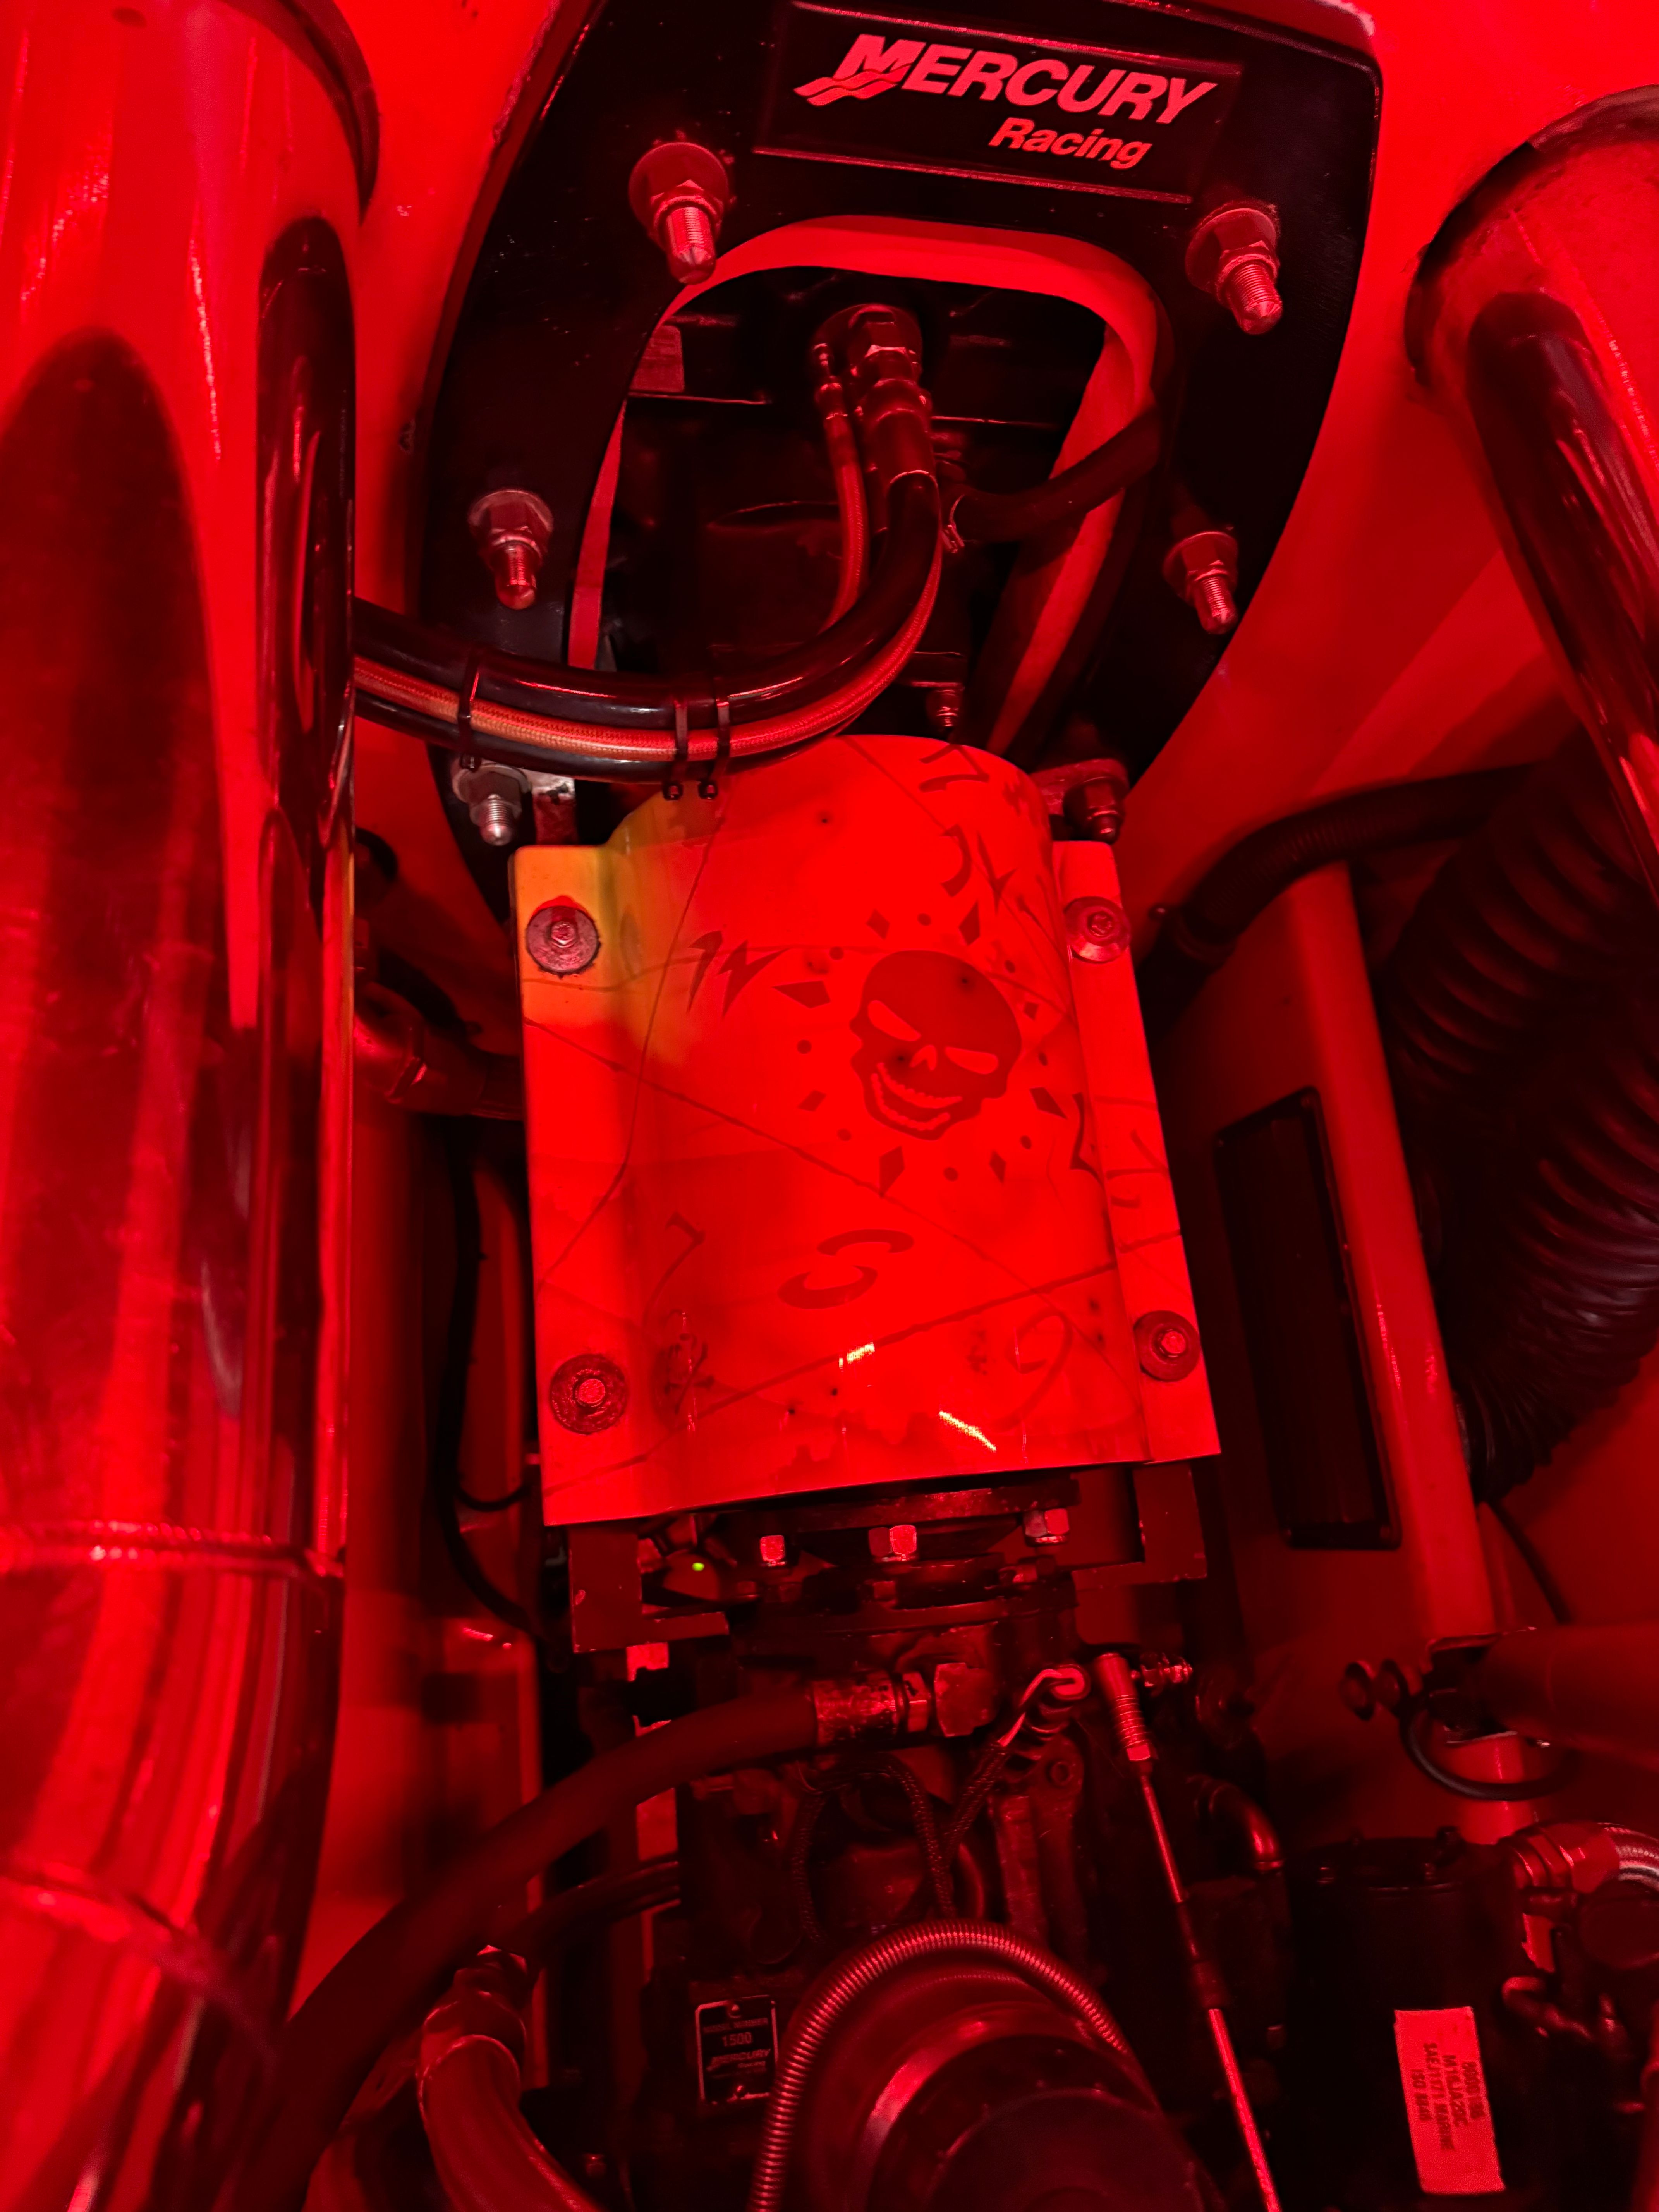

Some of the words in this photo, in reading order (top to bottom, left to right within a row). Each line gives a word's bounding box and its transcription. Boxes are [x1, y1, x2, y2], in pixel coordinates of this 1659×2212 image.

[794, 33, 1218, 124] MERCURY
[988, 117, 1153, 170] Racing
[722, 2032, 752, 2047] 1500
[1411, 2069, 1427, 2088] ISO
